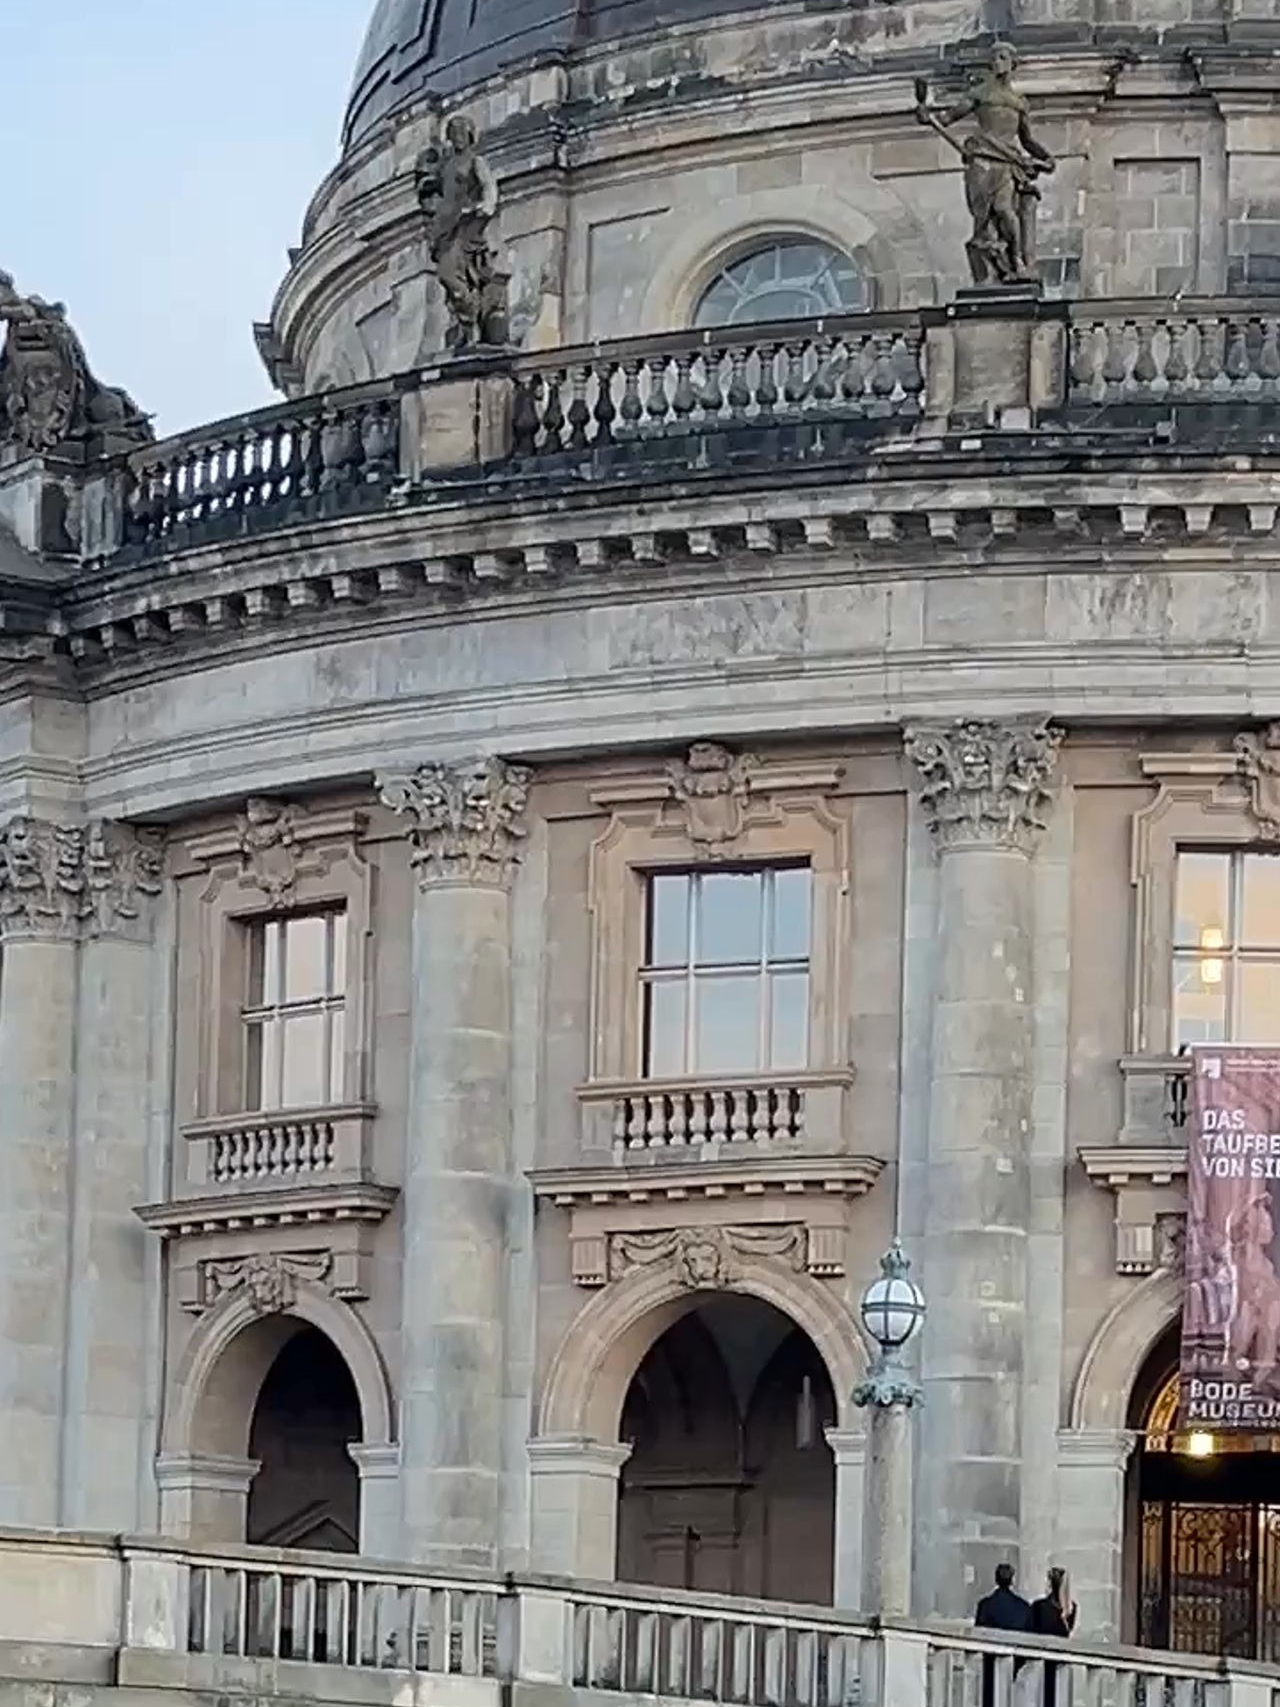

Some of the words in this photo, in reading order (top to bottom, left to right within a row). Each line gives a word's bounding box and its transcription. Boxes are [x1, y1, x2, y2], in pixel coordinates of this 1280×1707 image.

[1202, 1109, 1246, 1131] DAS
[1201, 1156, 1245, 1178] VON
[1189, 1378, 1254, 1401] BODE
